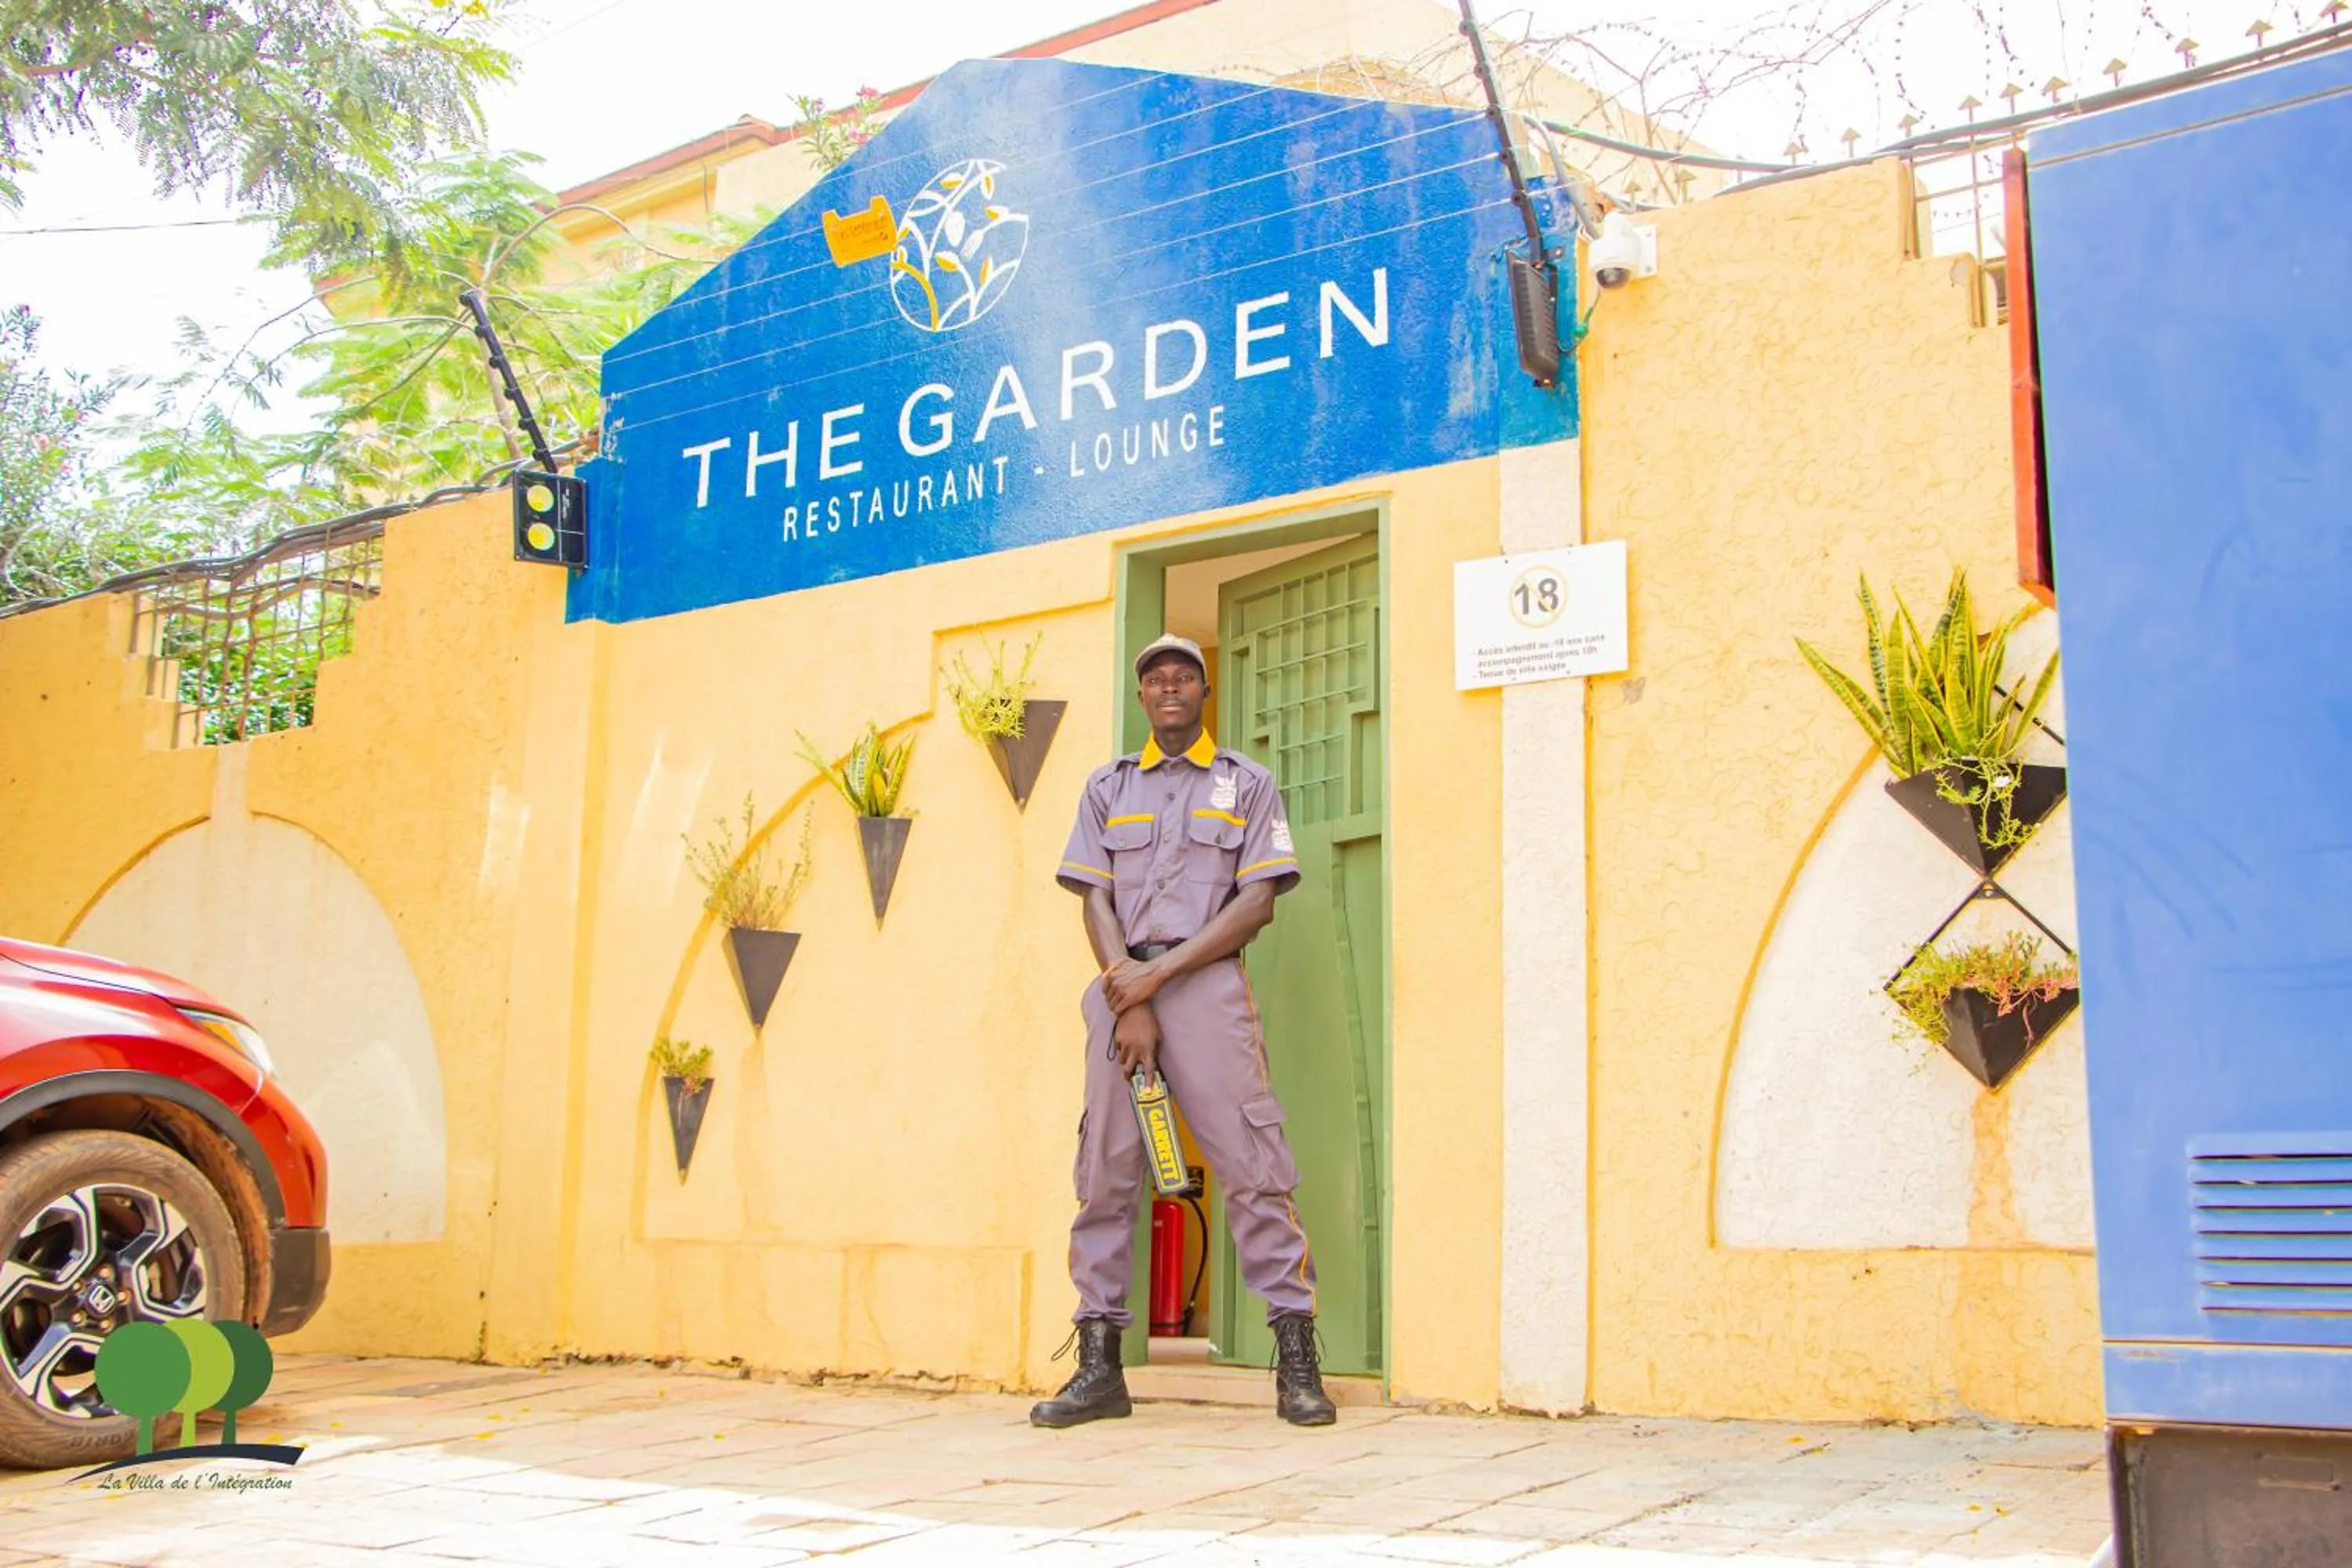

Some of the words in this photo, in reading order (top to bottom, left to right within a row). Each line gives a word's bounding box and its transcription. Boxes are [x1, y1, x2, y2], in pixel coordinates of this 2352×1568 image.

[681, 401, 866, 509] THE
[896, 267, 1390, 457] GARDEN
[782, 456, 1009, 543] RESTAURANT
[1069, 405, 1225, 478] LOUNGE
[1513, 577, 1559, 616] 18
